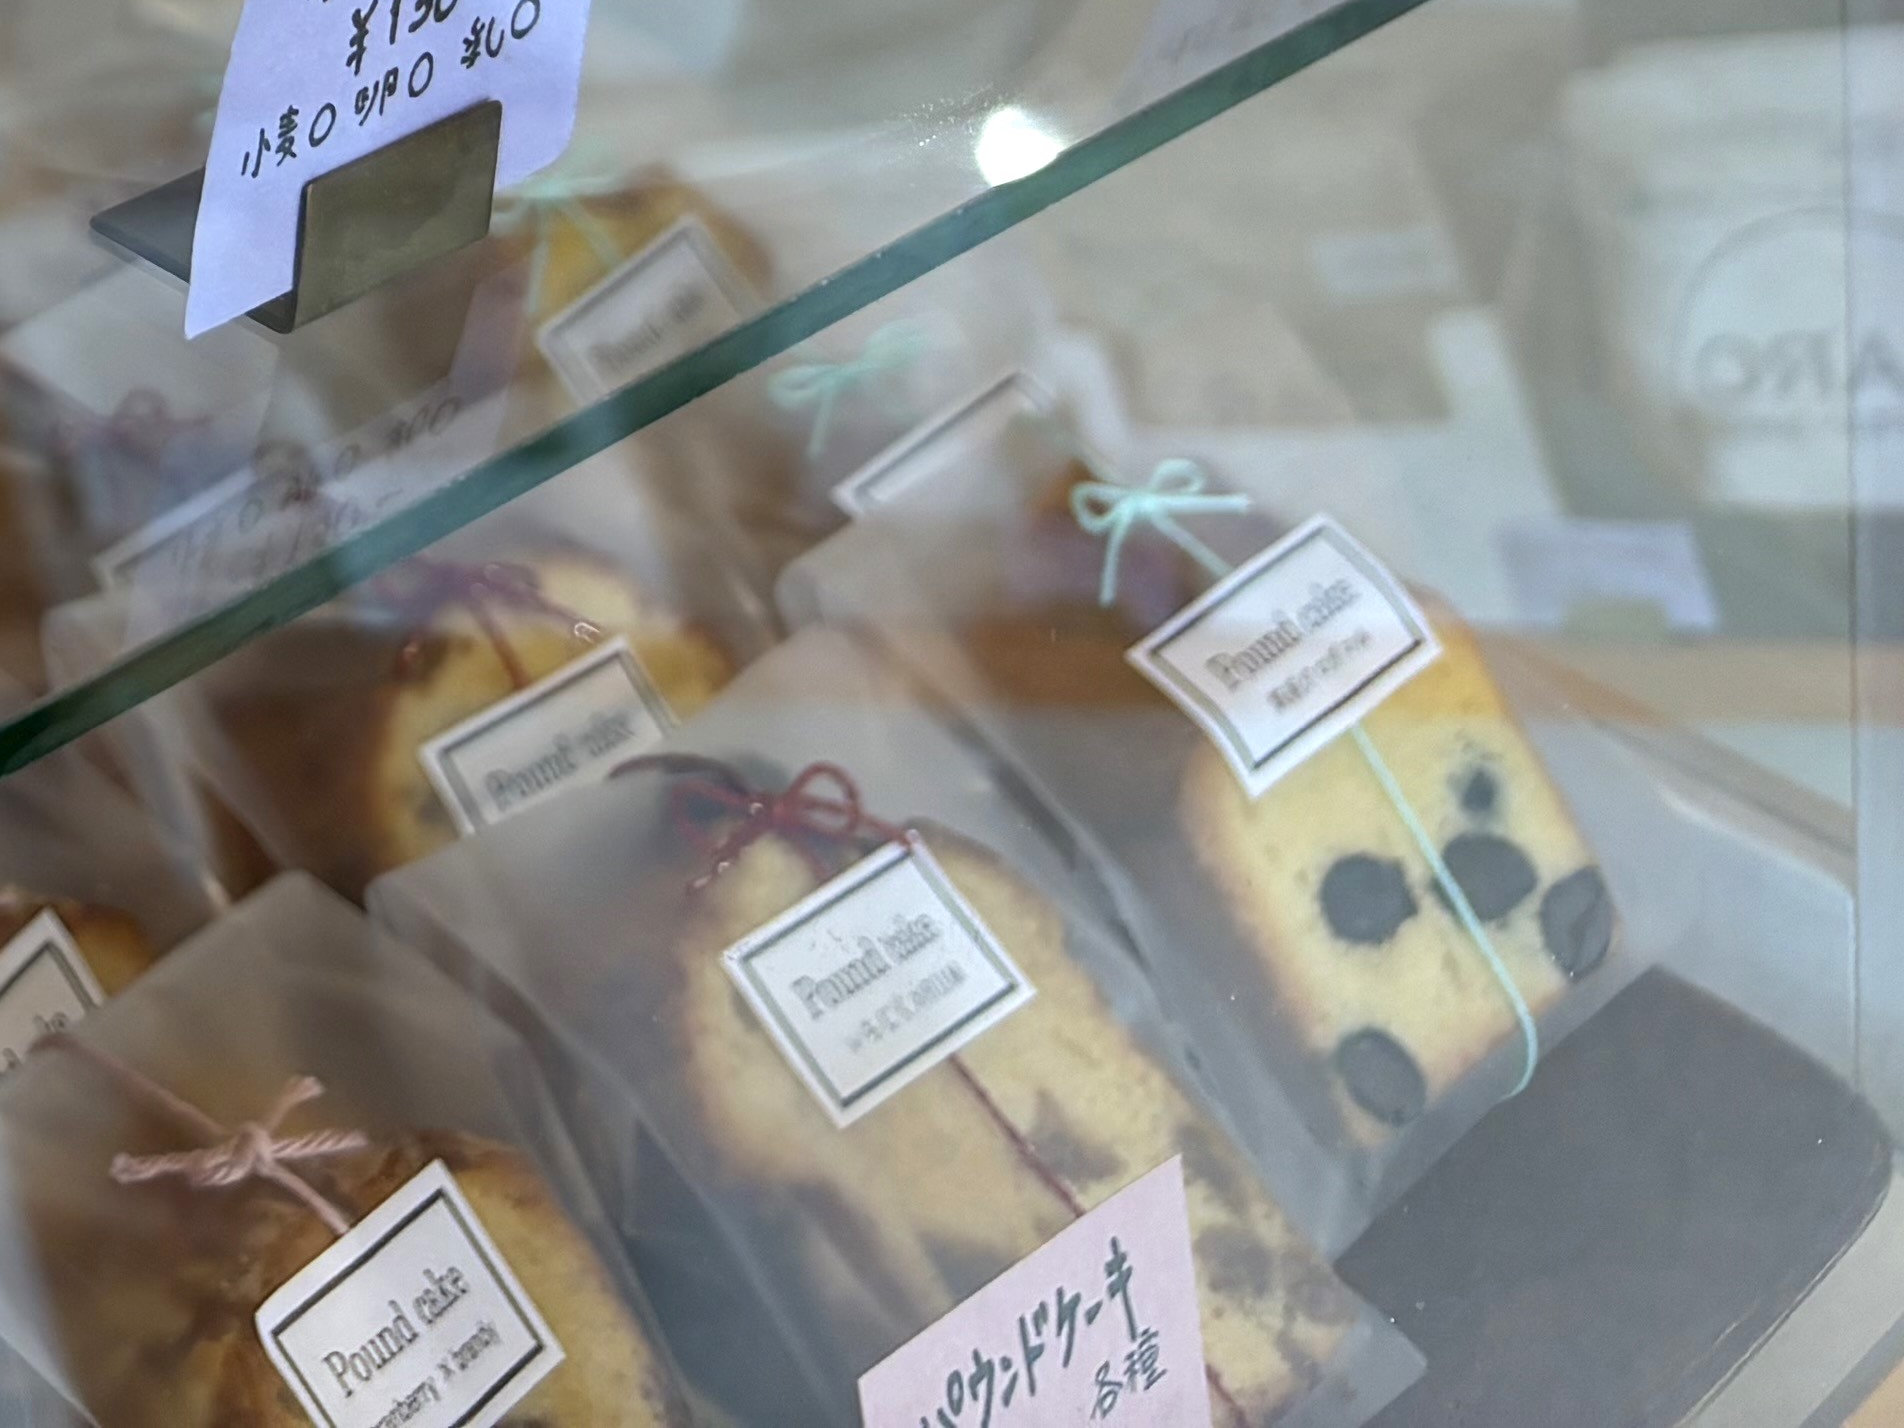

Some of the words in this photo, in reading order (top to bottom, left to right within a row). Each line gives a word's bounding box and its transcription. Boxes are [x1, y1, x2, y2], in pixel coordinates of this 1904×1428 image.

[790, 935, 891, 1020] Pound
[322, 1300, 419, 1398] Pound
[411, 1267, 470, 1324] cake
[1090, 1328, 1169, 1420] 各種
